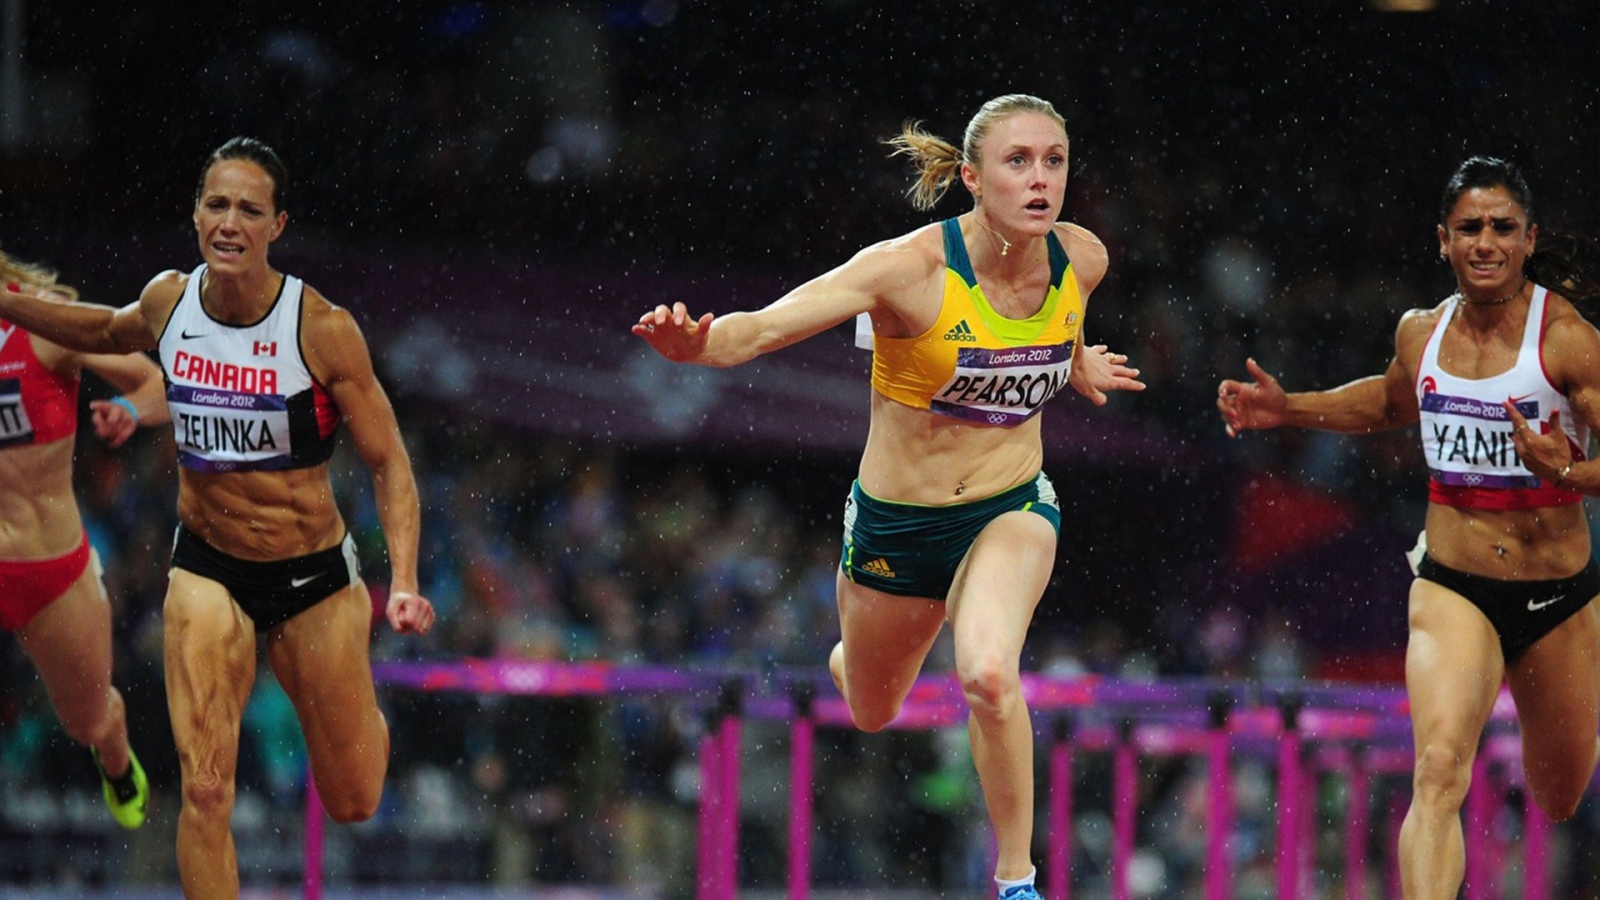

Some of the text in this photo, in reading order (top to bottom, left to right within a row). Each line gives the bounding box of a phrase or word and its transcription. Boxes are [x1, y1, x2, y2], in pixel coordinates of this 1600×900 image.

[943, 333, 977, 342] adidas
[989, 350, 1052, 364] London 2012
[173, 351, 277, 394] CANADA
[942, 369, 1067, 409] PEARSON
[191, 390, 256, 408] London 2012
[1444, 401, 1506, 418] London 2012
[179, 413, 277, 454] ZELINKA
[862, 564, 896, 578] adidas
